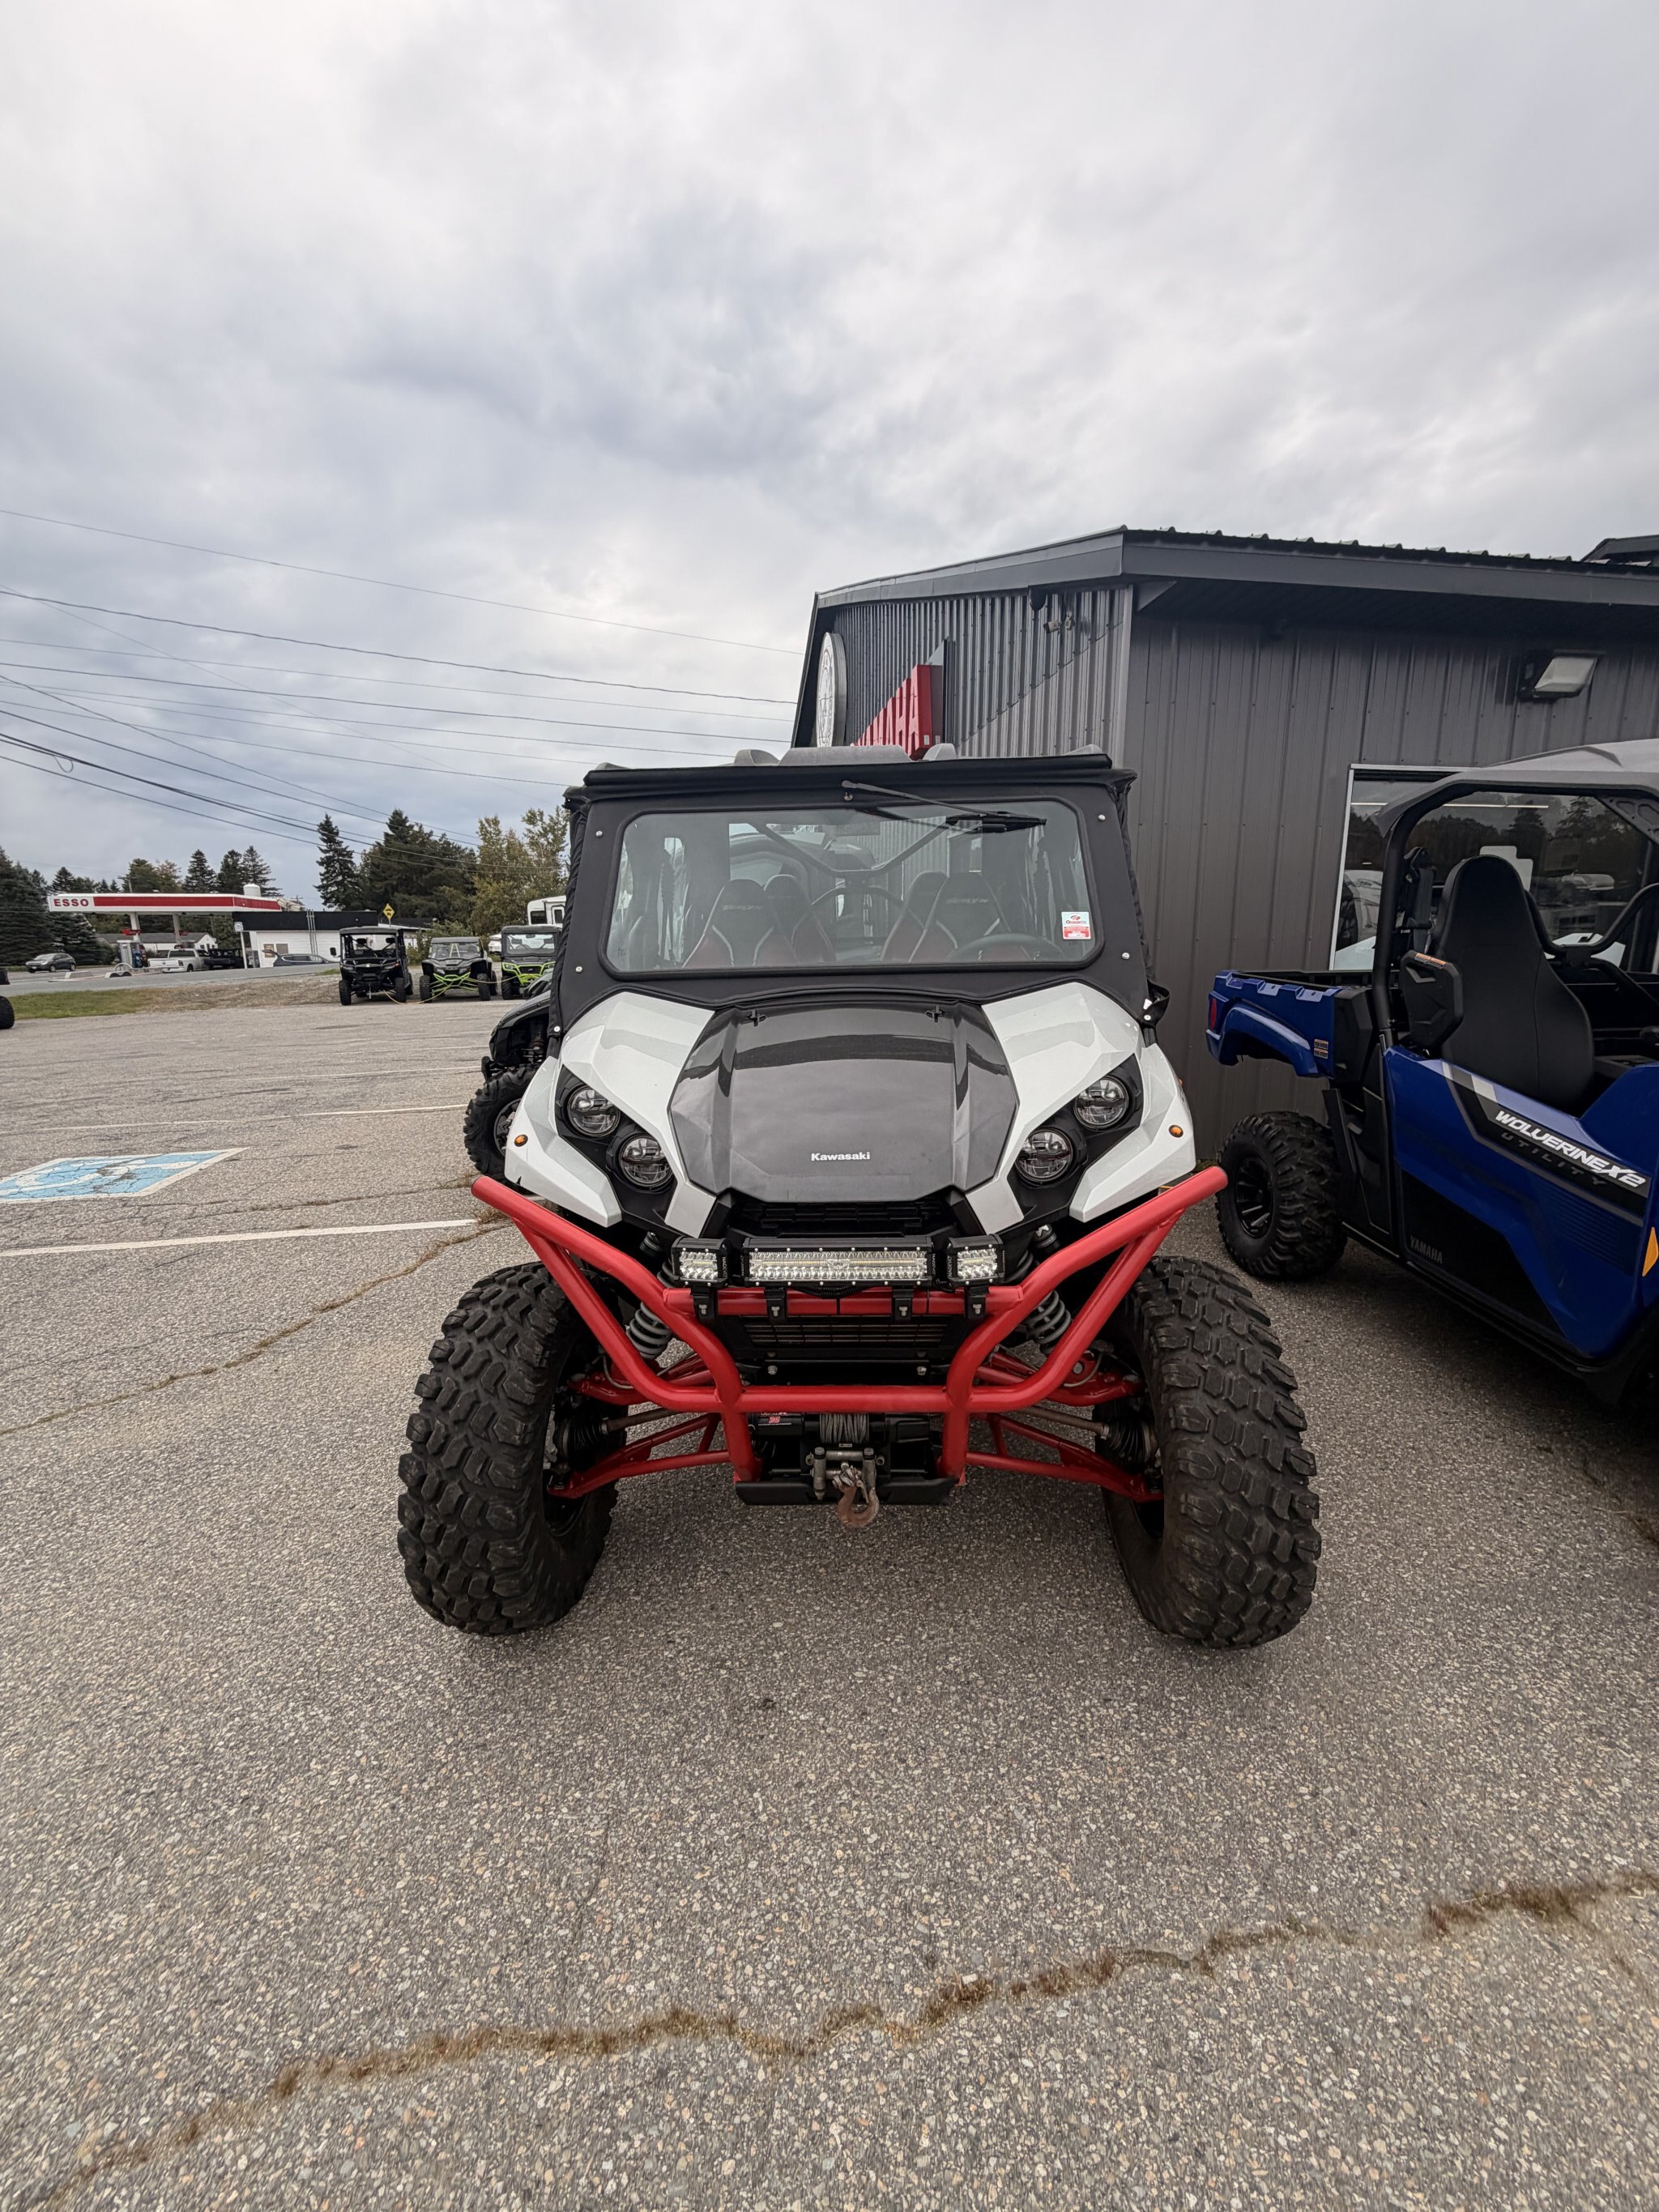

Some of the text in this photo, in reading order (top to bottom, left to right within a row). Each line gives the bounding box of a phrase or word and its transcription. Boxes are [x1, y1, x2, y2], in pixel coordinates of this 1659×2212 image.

[53, 898, 89, 907] ESSO
[811, 1152, 871, 1161] Kawasaki
[1500, 1132, 1607, 1185] UTILITY
[1410, 1234, 1443, 1264] YAMAHA
